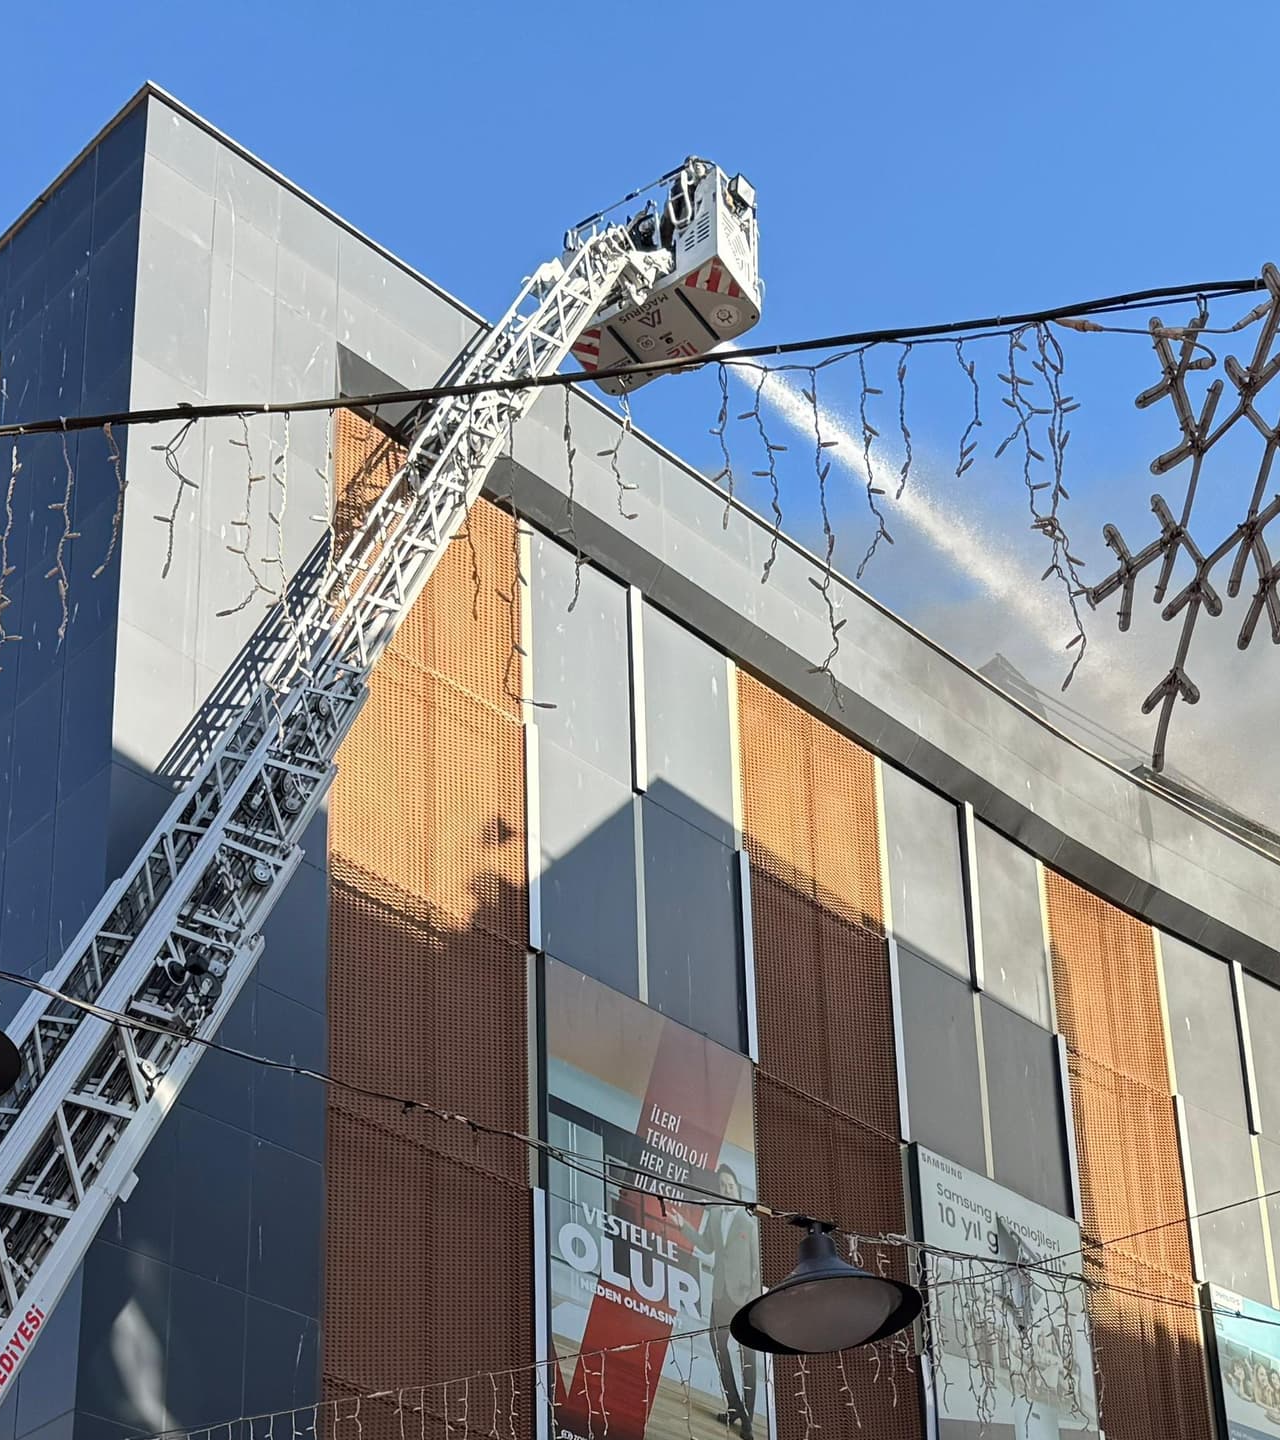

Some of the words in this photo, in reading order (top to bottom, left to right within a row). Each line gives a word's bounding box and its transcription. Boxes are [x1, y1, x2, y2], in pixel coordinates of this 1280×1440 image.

[650, 1103, 681, 1133] İLERİ
[639, 1150, 664, 1175] HER
[666, 1163, 689, 1183] EVE
[646, 1128, 708, 1170] TEKNOLOJİ
[921, 1152, 963, 1180] SAMSUNG
[936, 1182, 992, 1223] Samsung
[582, 1202, 679, 1262] VESTEL'LE
[938, 1202, 956, 1228] 10
[961, 1216, 982, 1241] yıl
[580, 1277, 622, 1305] NEDEN
